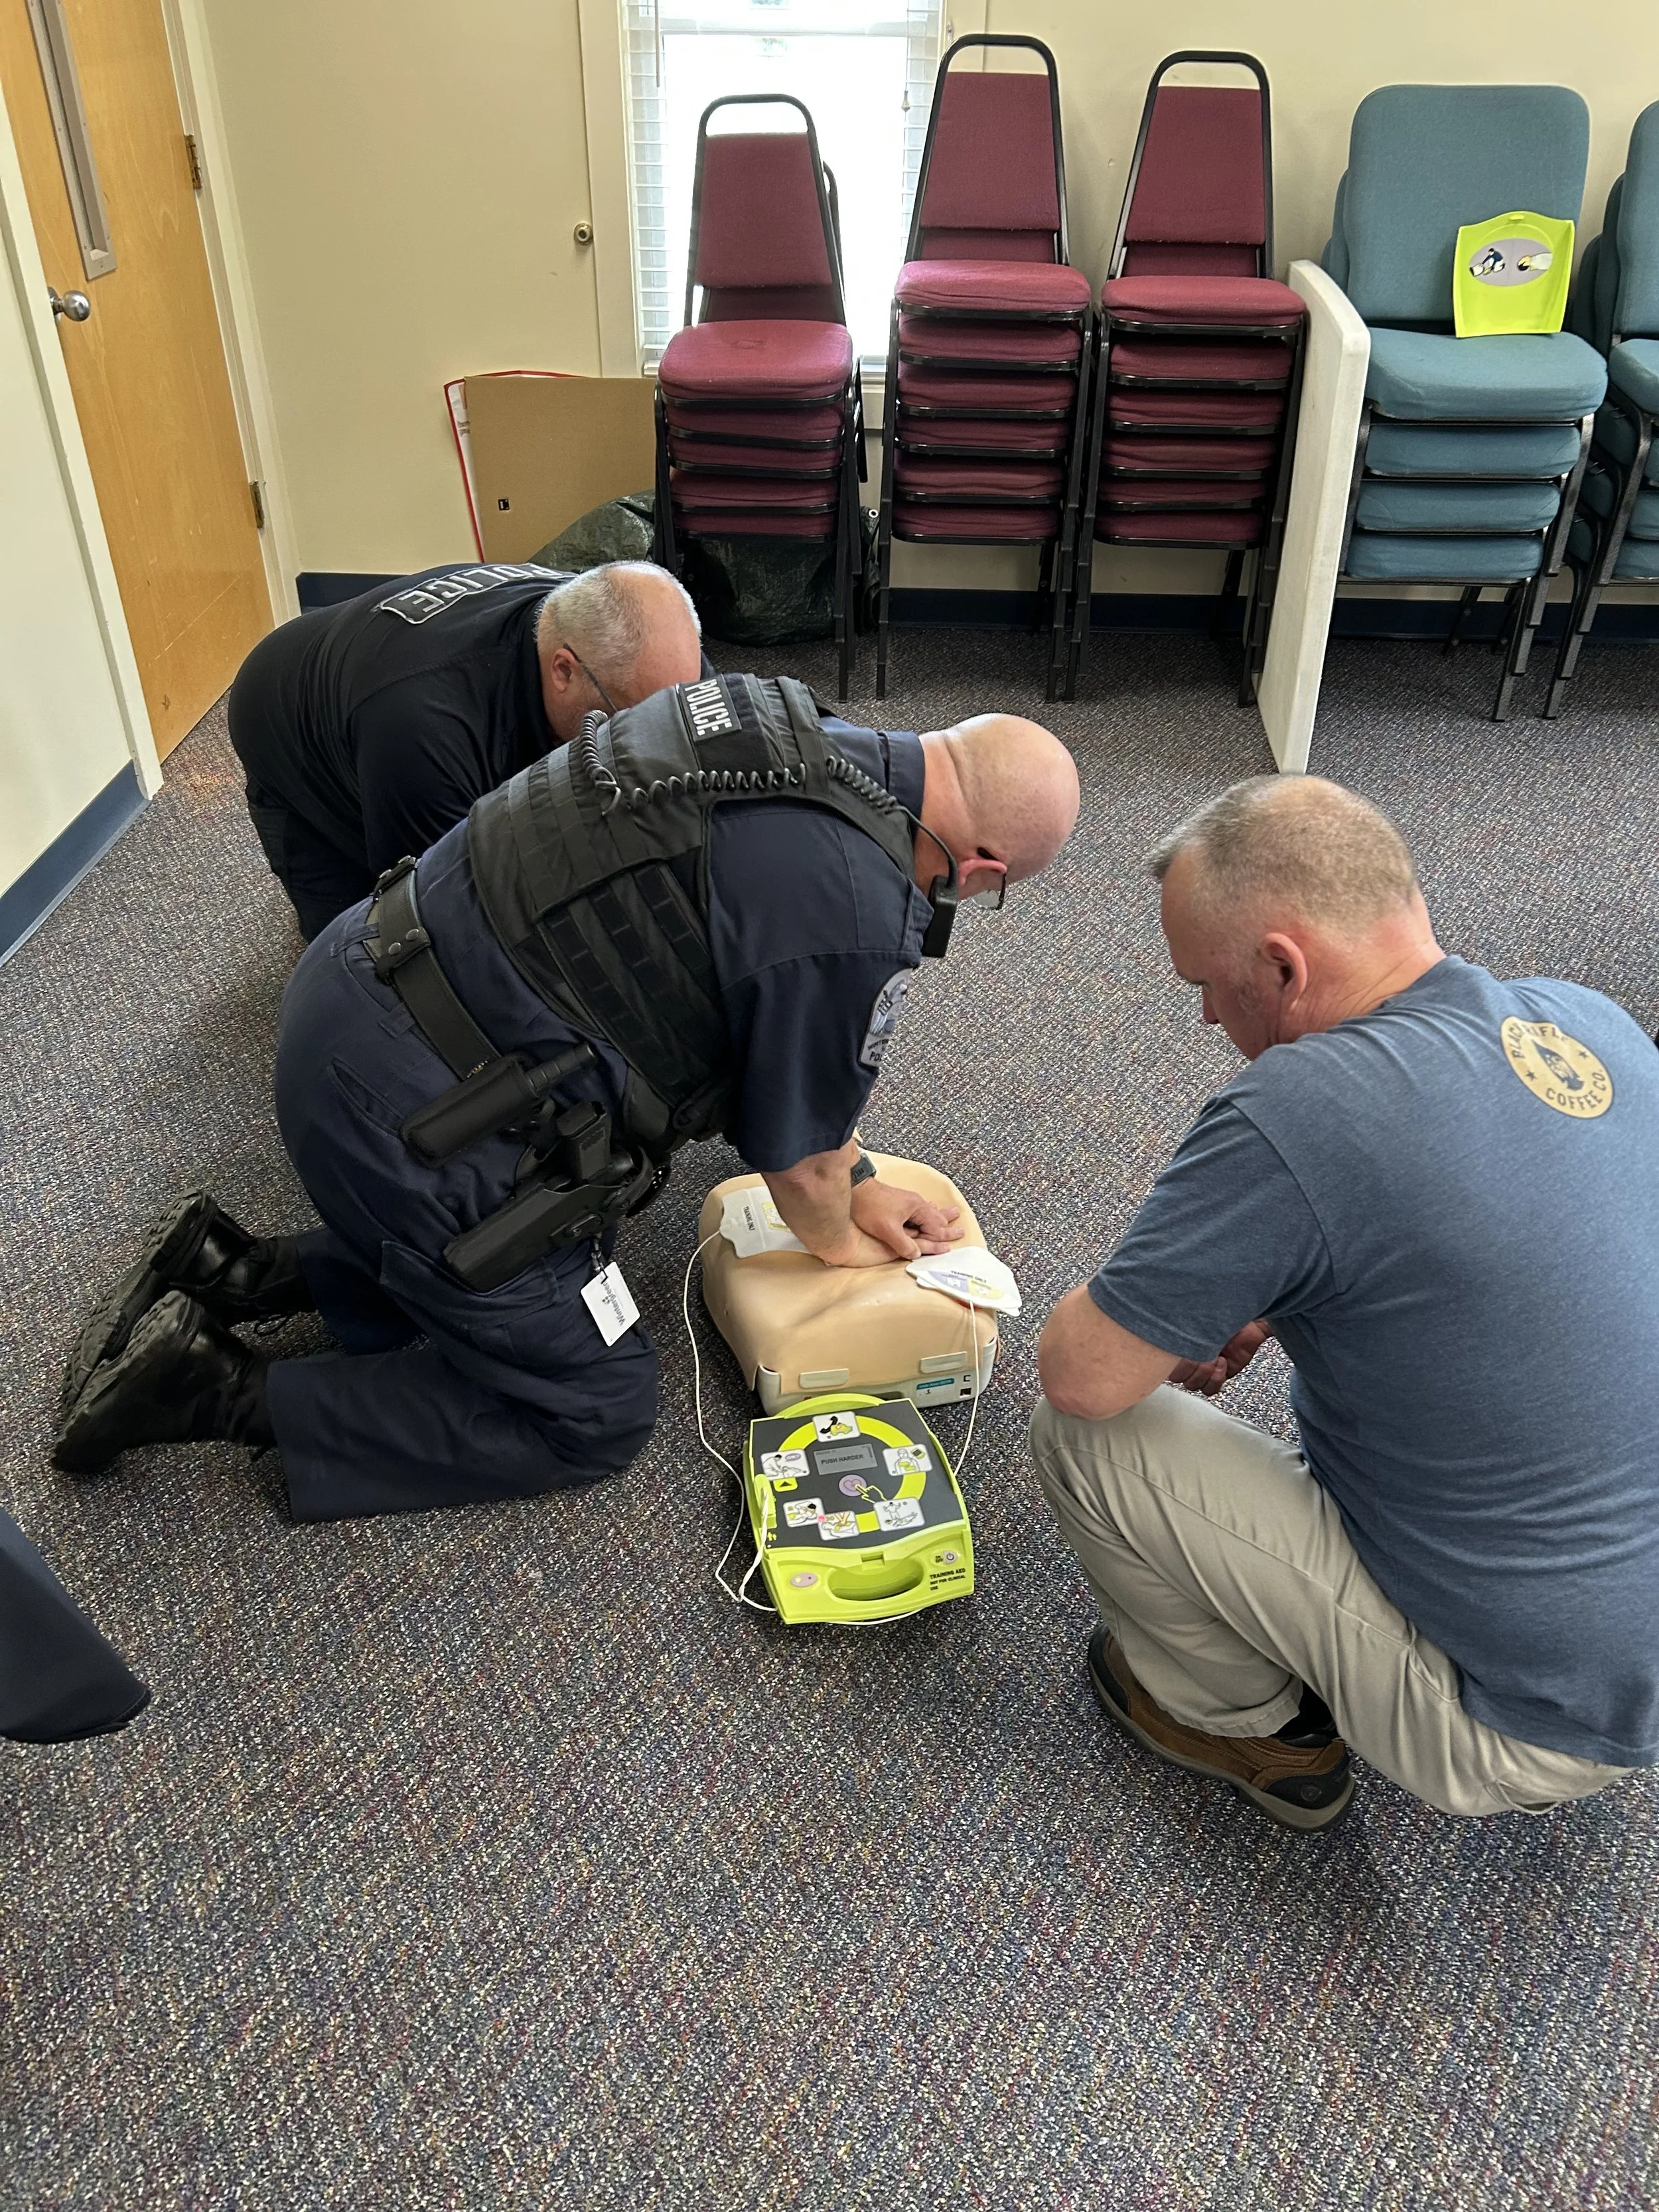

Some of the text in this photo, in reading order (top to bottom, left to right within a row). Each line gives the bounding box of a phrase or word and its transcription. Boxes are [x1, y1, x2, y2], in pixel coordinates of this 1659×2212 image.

[397, 564, 564, 613] POLICE
[684, 678, 733, 736] POLICE
[1546, 1087, 1603, 1110] COFFEE
[601, 1280, 626, 1326] Wintergreen
[930, 1570, 954, 1579] TRAINING
